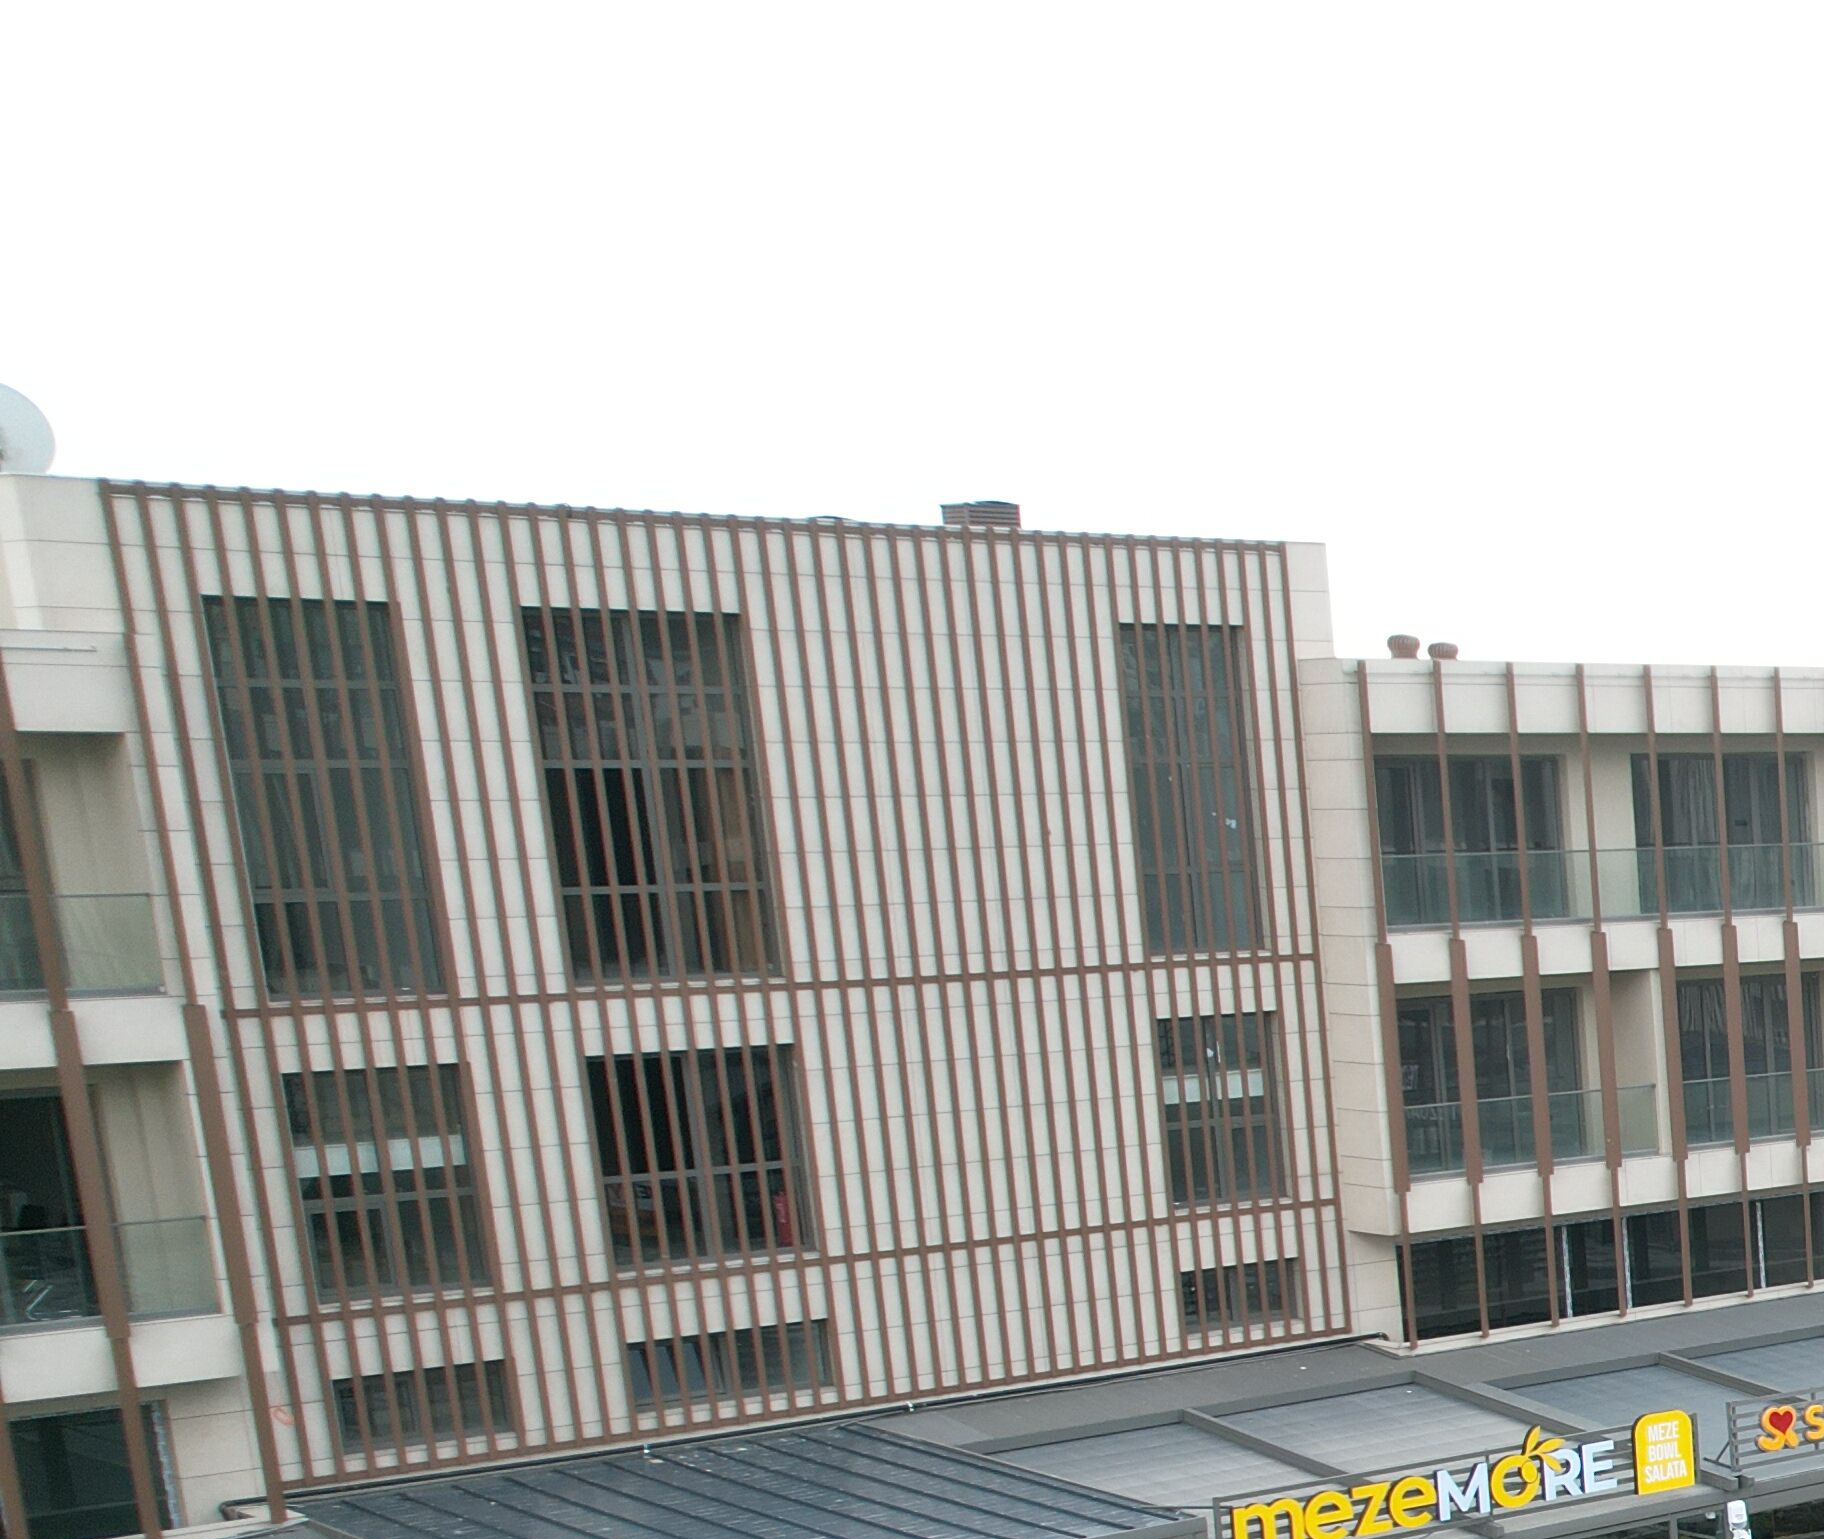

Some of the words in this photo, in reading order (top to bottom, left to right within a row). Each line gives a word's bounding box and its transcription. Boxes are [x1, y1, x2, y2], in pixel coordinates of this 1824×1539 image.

[1647, 1420, 1680, 1443] MEZE
[1648, 1441, 1682, 1462] BOWL
[1644, 1459, 1688, 1484] SALATA
